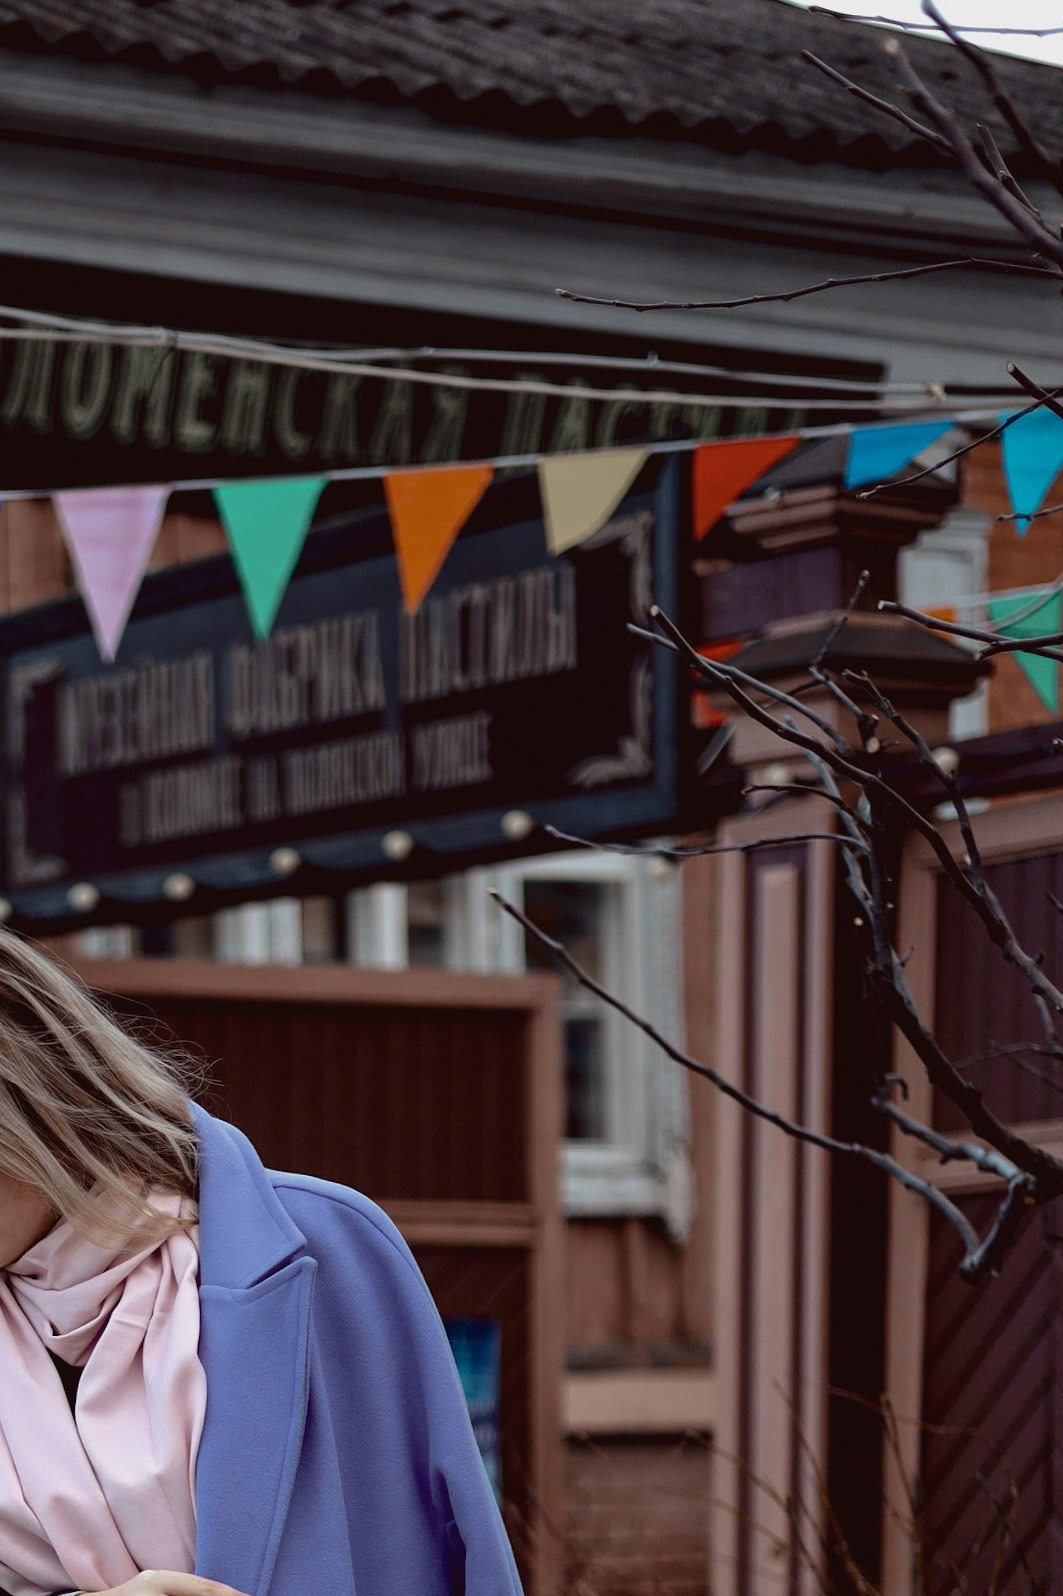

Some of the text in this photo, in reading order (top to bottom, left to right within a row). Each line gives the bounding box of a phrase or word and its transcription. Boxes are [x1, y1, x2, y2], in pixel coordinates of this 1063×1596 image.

[500, 371, 808, 476] ПАСТ
[58, 563, 578, 777] МУЗЕЙНАЯ ФАБРИКА ПАСТИЛЫ
